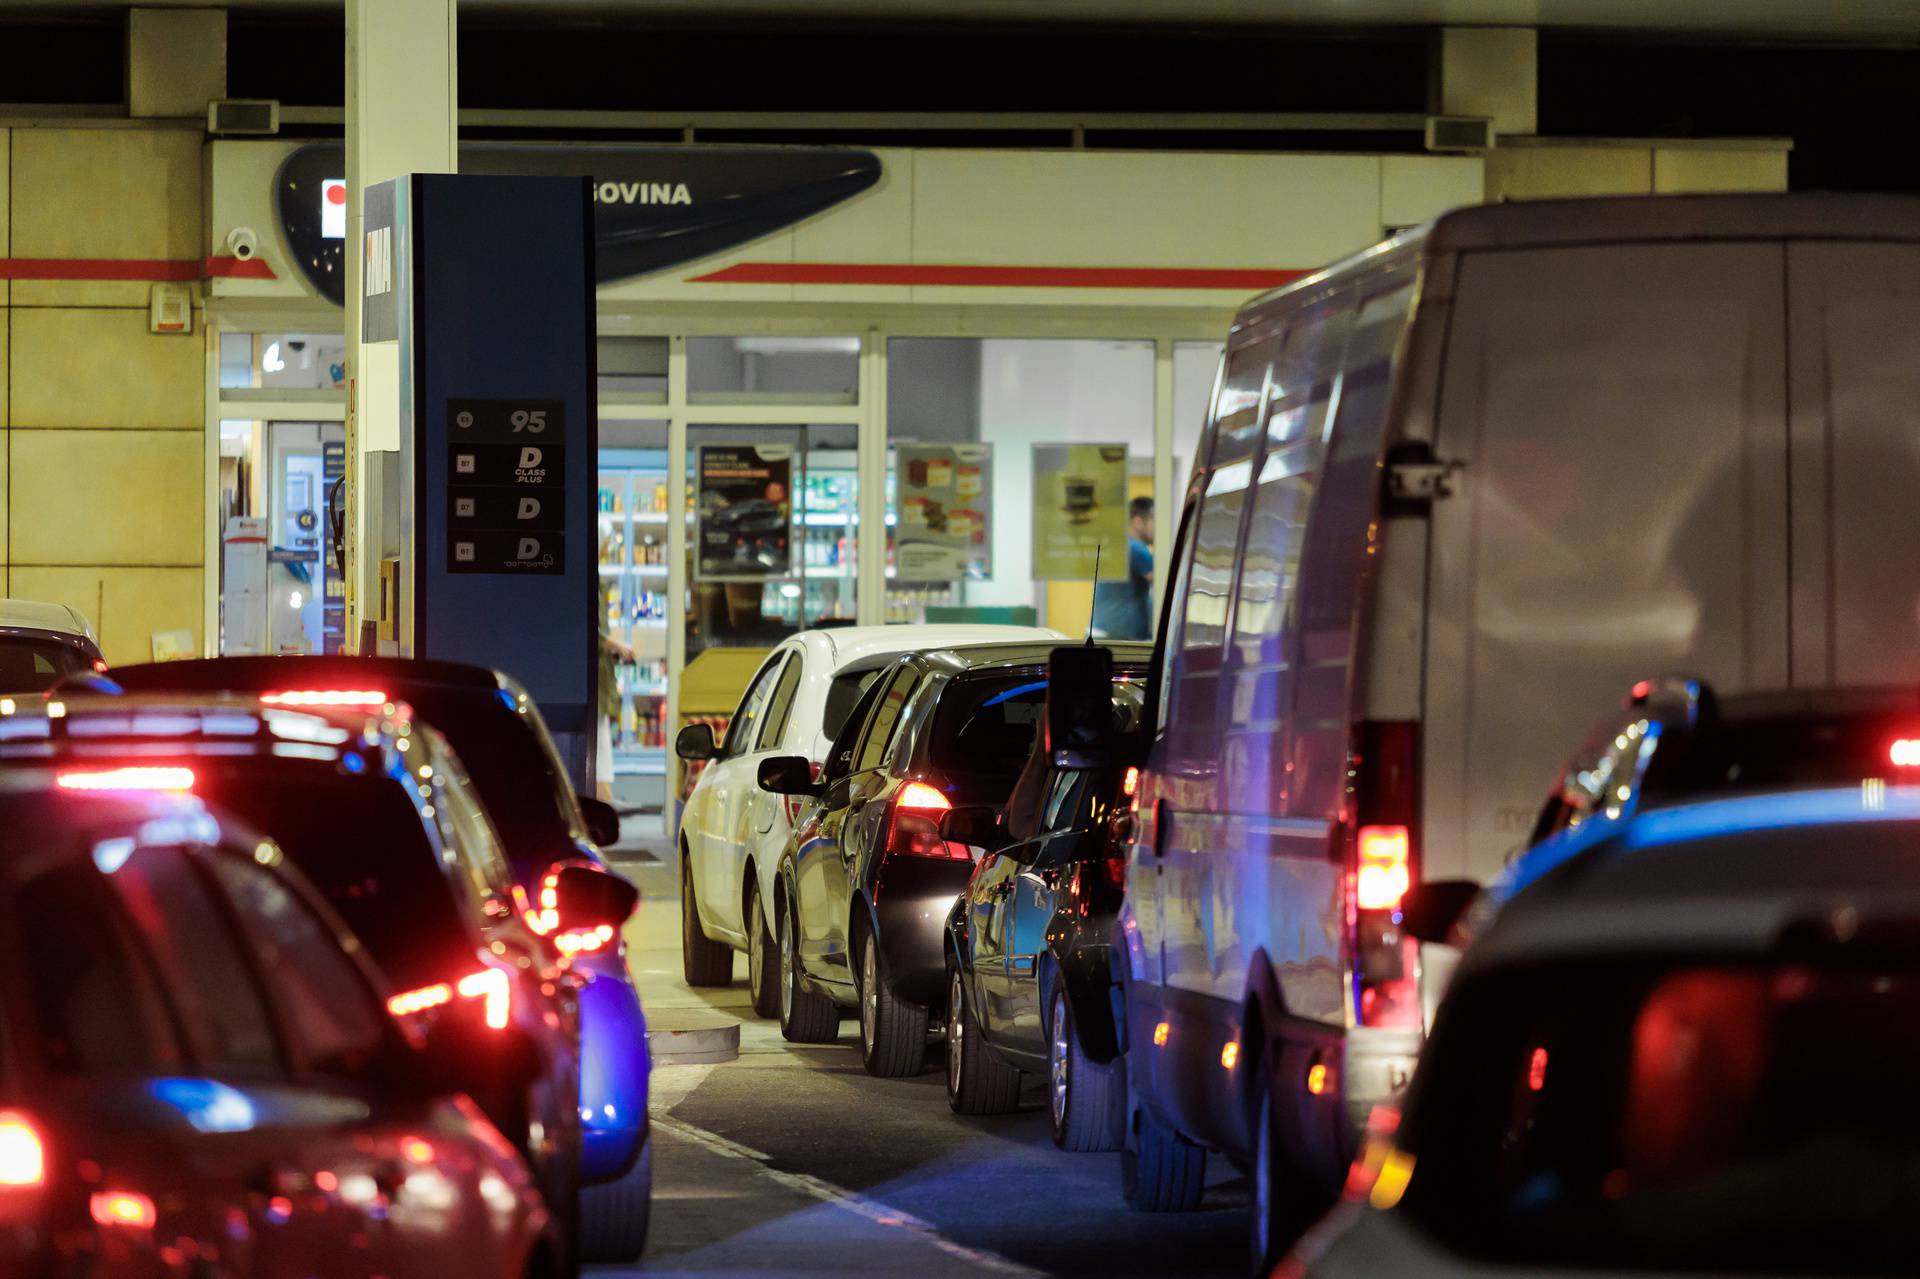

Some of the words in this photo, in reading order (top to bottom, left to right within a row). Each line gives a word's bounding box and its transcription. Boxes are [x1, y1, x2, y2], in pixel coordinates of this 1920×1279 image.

[593, 182, 692, 205] OVINA
[511, 410, 546, 433] 95
[519, 446, 543, 468] D
[517, 497, 542, 520] D
[517, 537, 541, 560] D
